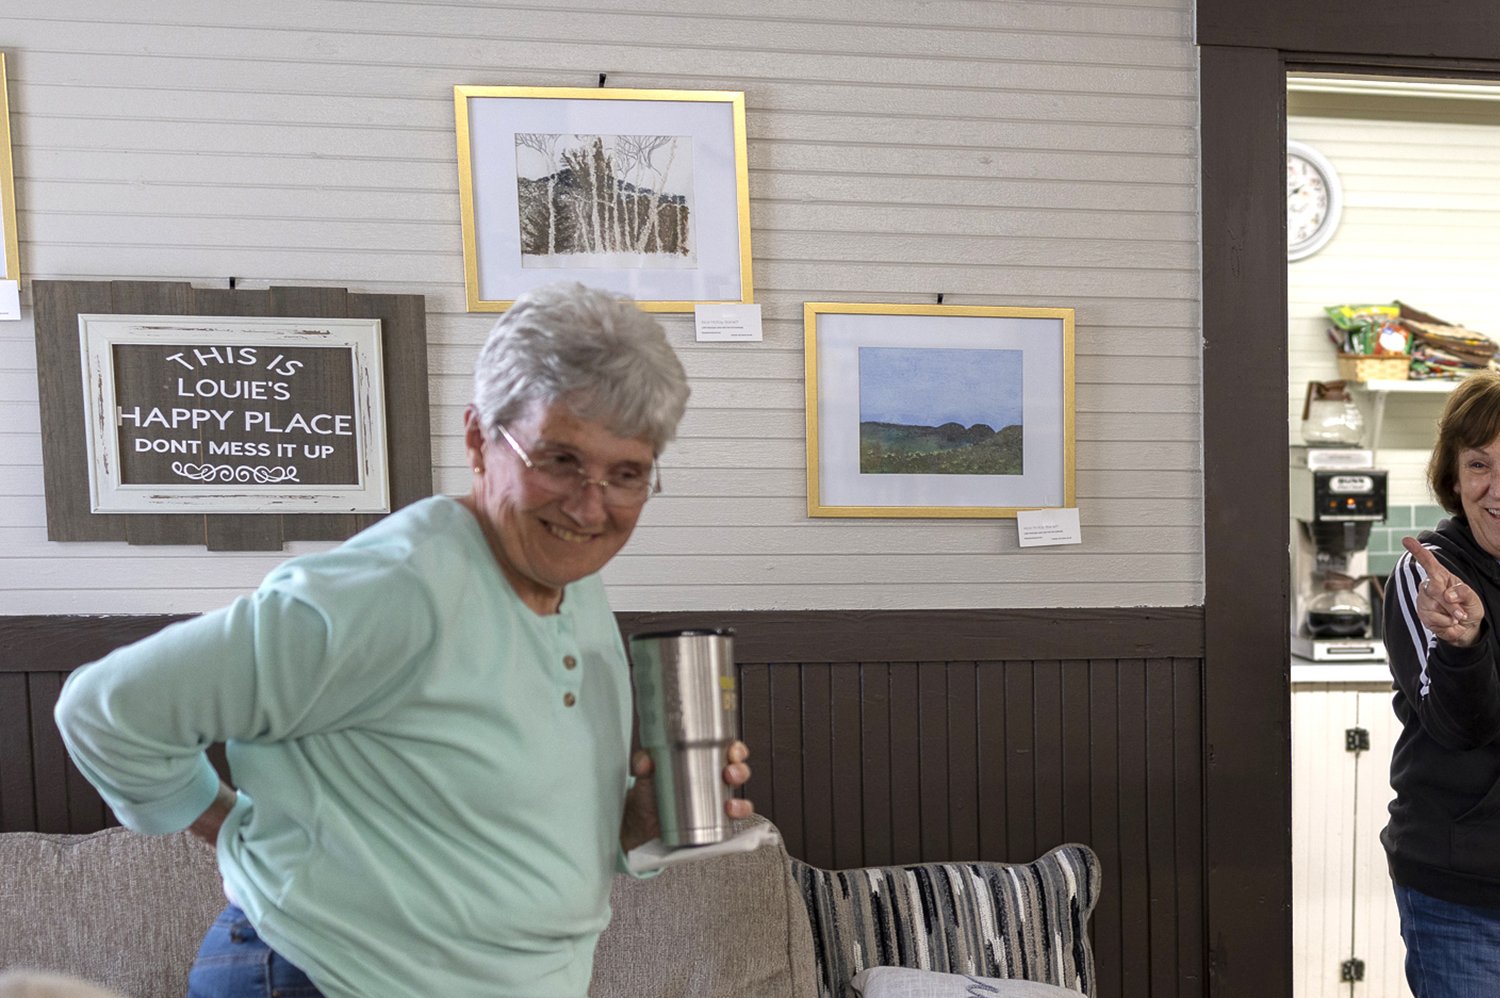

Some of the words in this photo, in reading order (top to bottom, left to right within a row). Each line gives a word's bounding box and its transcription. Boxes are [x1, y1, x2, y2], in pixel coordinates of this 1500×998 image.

[166, 346, 258, 371] THIS
[266, 354, 304, 376] IS
[177, 377, 291, 401] LOUIE'S
[117, 406, 234, 430] HAPPY
[244, 411, 353, 435] PLACE
[135, 438, 202, 454] DONT
[209, 441, 271, 457] MESS
[277, 443, 297, 458] IT
[304, 445, 335, 459] UP
